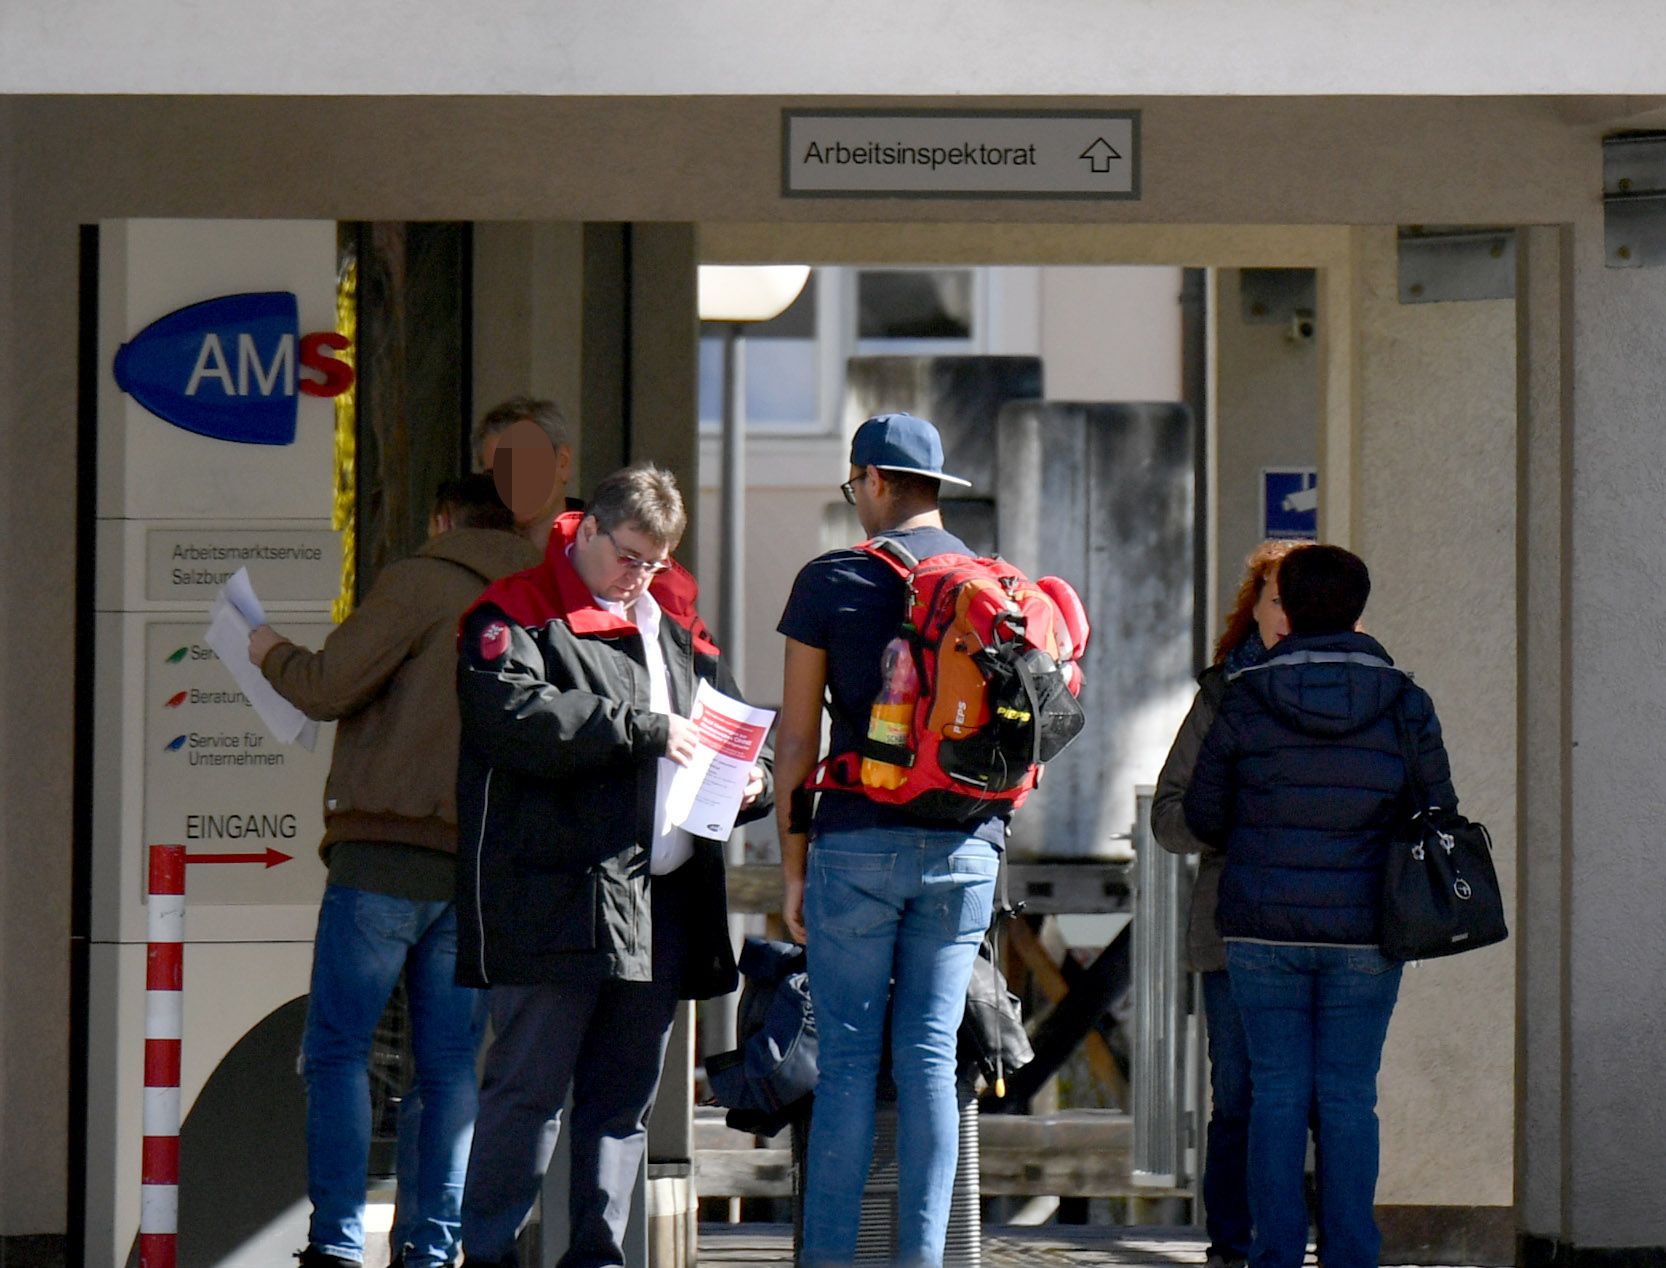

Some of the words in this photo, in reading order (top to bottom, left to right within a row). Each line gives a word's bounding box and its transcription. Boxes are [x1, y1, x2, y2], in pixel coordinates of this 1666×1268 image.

[803, 141, 1036, 170] Arbeitsinspektorat
[184, 331, 354, 398] AMS
[172, 544, 322, 561] Arbeitsmarktservice
[172, 568, 234, 586] Salzbur
[189, 732, 240, 749] Service
[244, 732, 264, 749] für
[189, 751, 284, 766] Unternehmen
[186, 814, 297, 840] EINGANG
